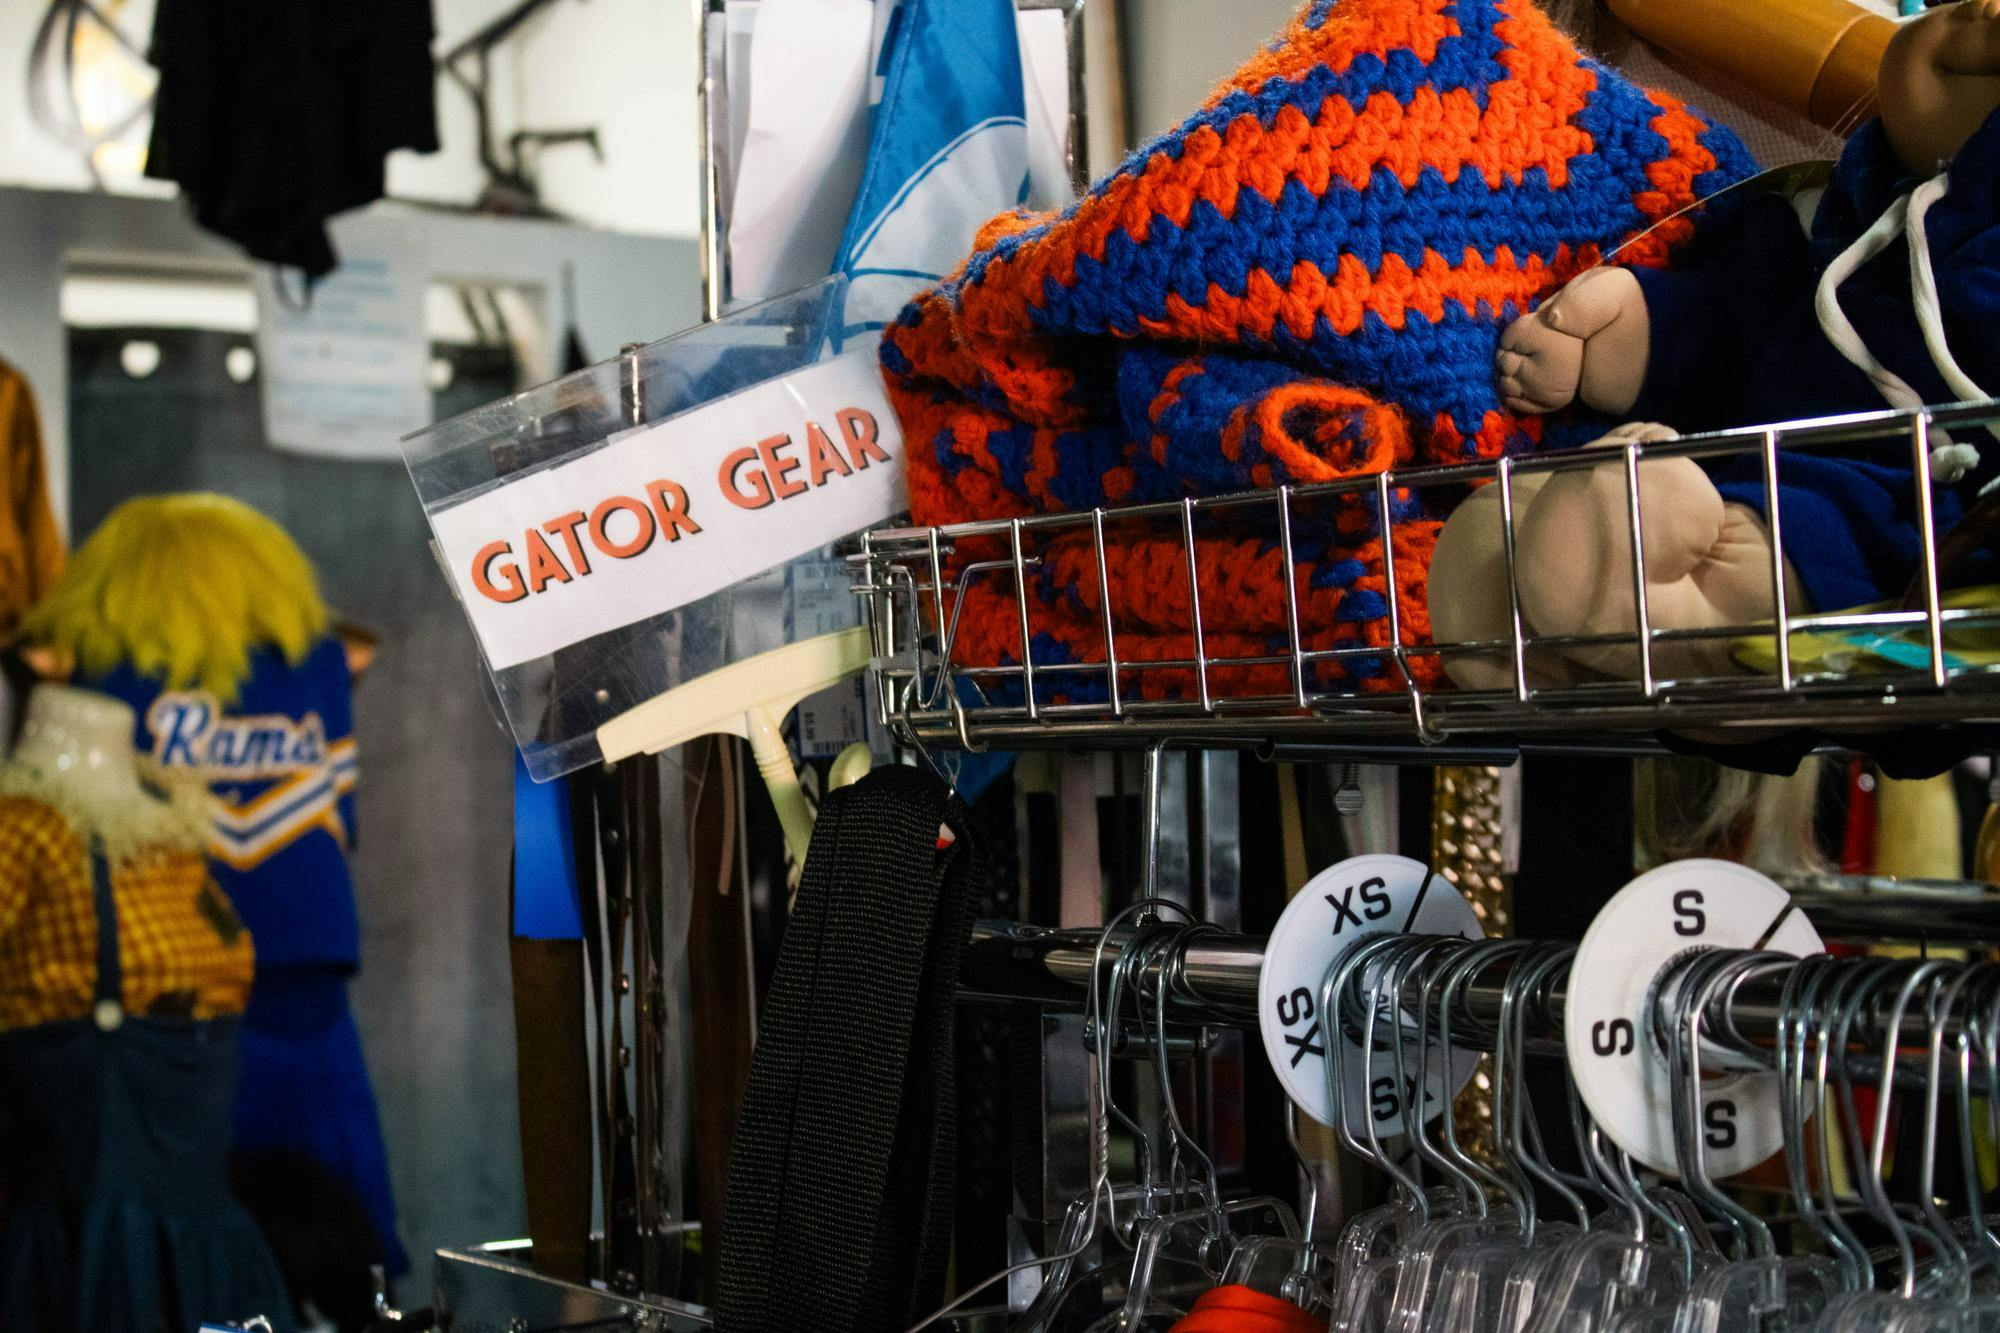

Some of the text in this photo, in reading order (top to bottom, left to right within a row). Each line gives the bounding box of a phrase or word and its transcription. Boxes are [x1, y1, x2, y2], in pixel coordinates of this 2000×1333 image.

[471, 478, 703, 603] GATOR
[718, 407, 892, 510] GEAR
[151, 697, 324, 774] Rams
[1324, 876, 1391, 936] XS
[1673, 889, 1706, 937] S
[1276, 986, 1326, 1070] XS
[1591, 1017, 1635, 1057] S
[1704, 1099, 1737, 1149] S
